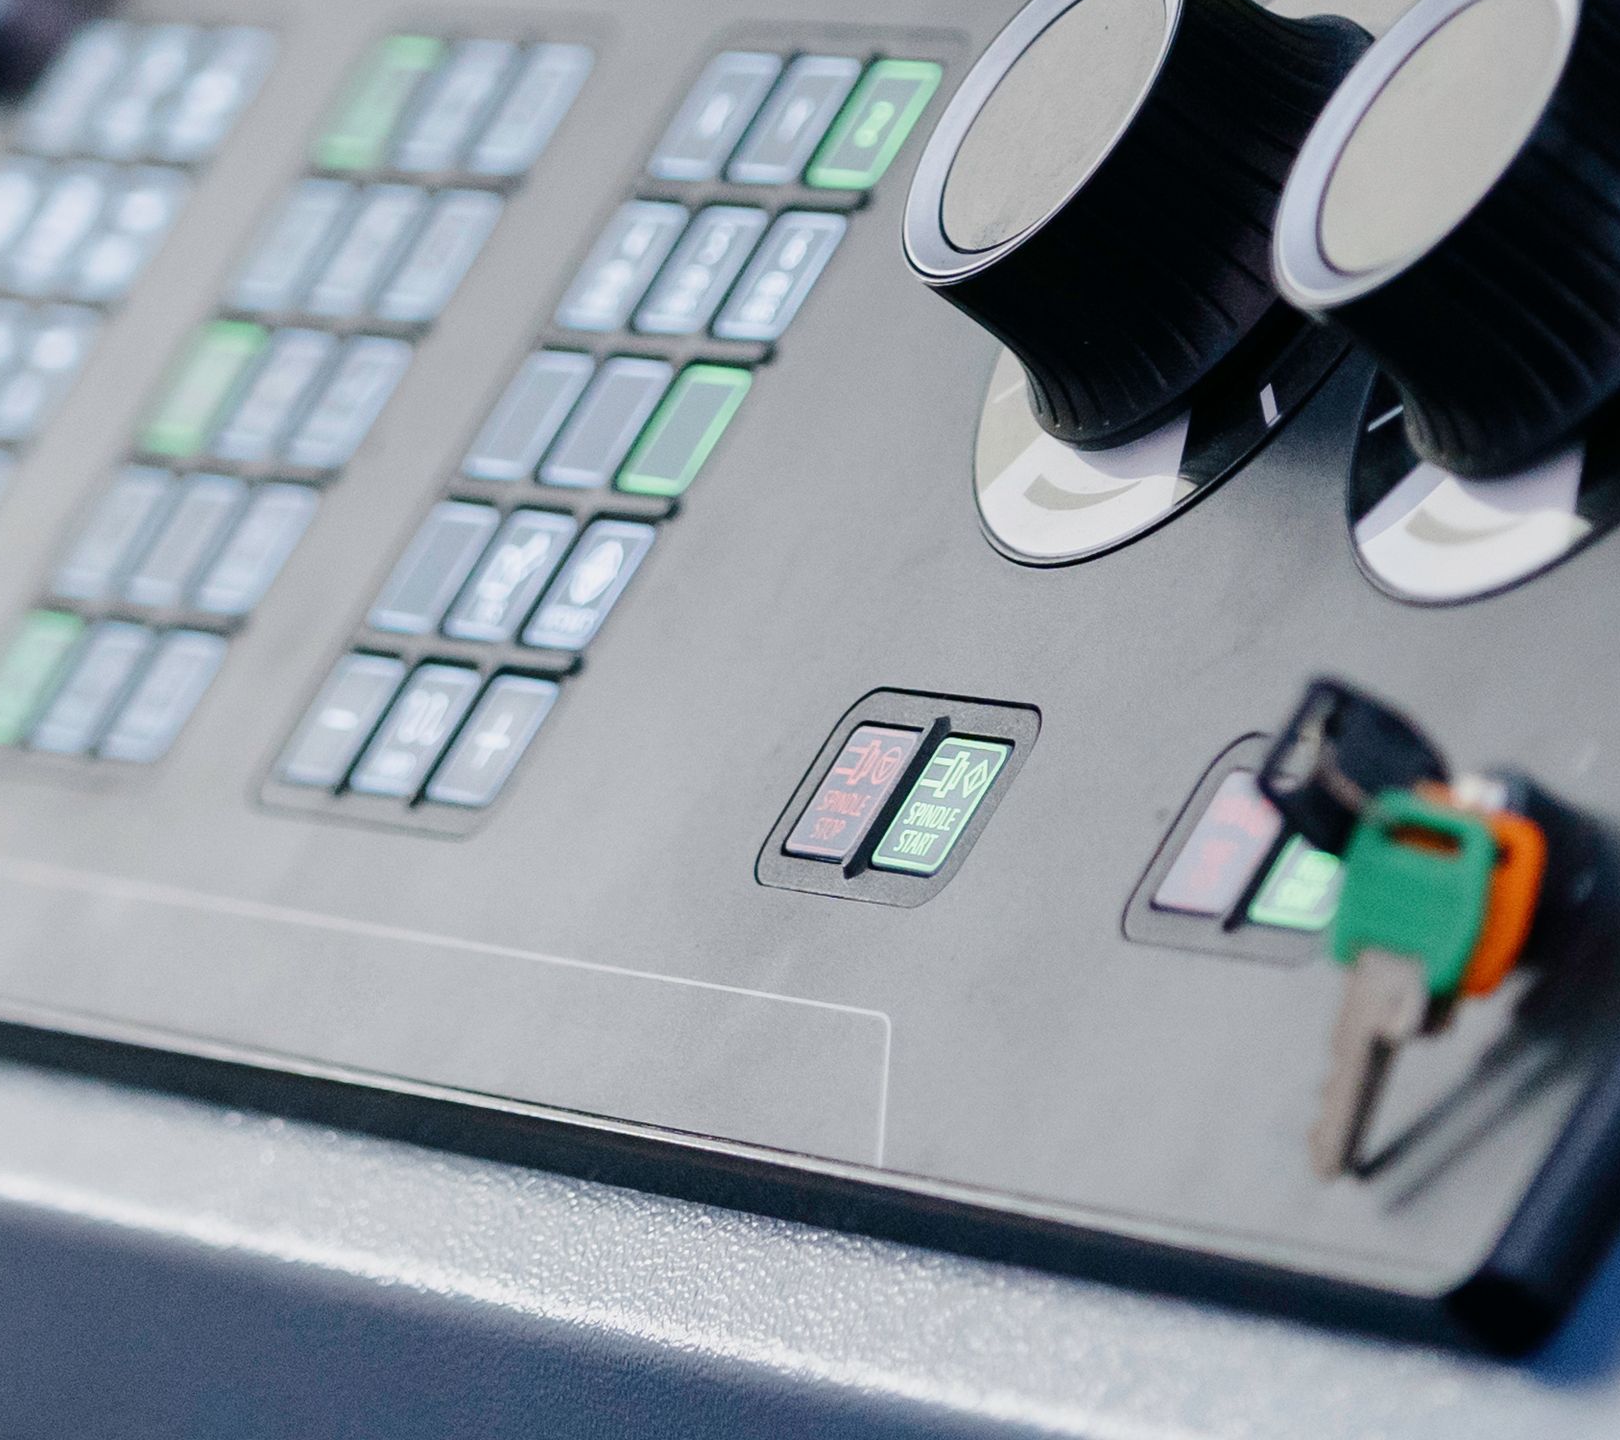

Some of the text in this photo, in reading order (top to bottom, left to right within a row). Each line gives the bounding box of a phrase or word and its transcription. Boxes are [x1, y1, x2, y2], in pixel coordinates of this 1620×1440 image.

[816, 790, 871, 816] SPINDLE
[903, 801, 960, 831] SPINDLE
[810, 816, 847, 840] STOP
[893, 829, 939, 856] START
